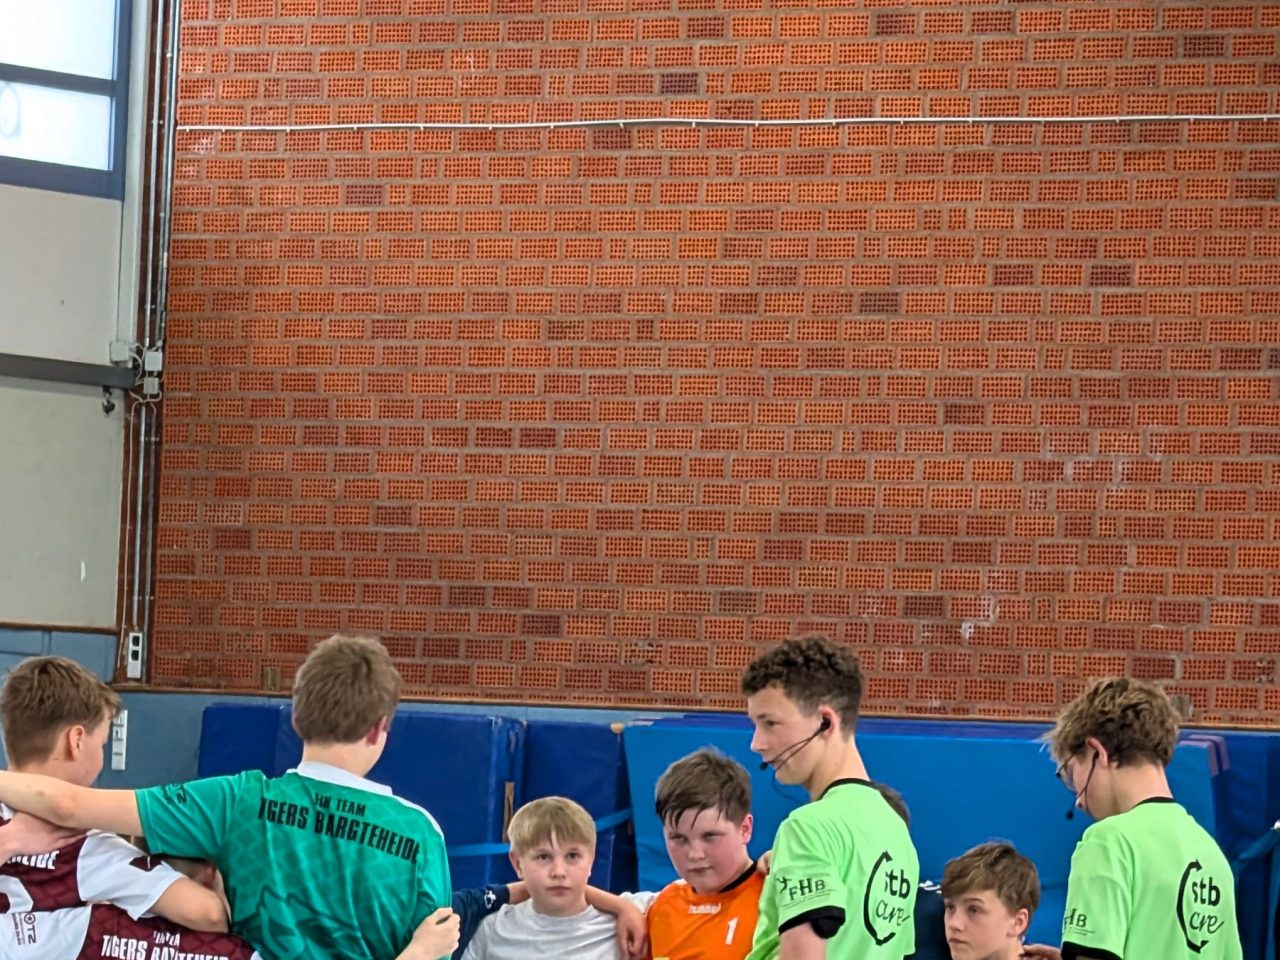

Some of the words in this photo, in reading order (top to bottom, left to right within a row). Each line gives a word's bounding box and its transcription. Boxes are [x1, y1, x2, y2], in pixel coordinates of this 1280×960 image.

[336, 798, 367, 817] TEAM
[789, 877, 826, 901] FHB
[1191, 877, 1221, 906] stb
[726, 916, 739, 945] 1
